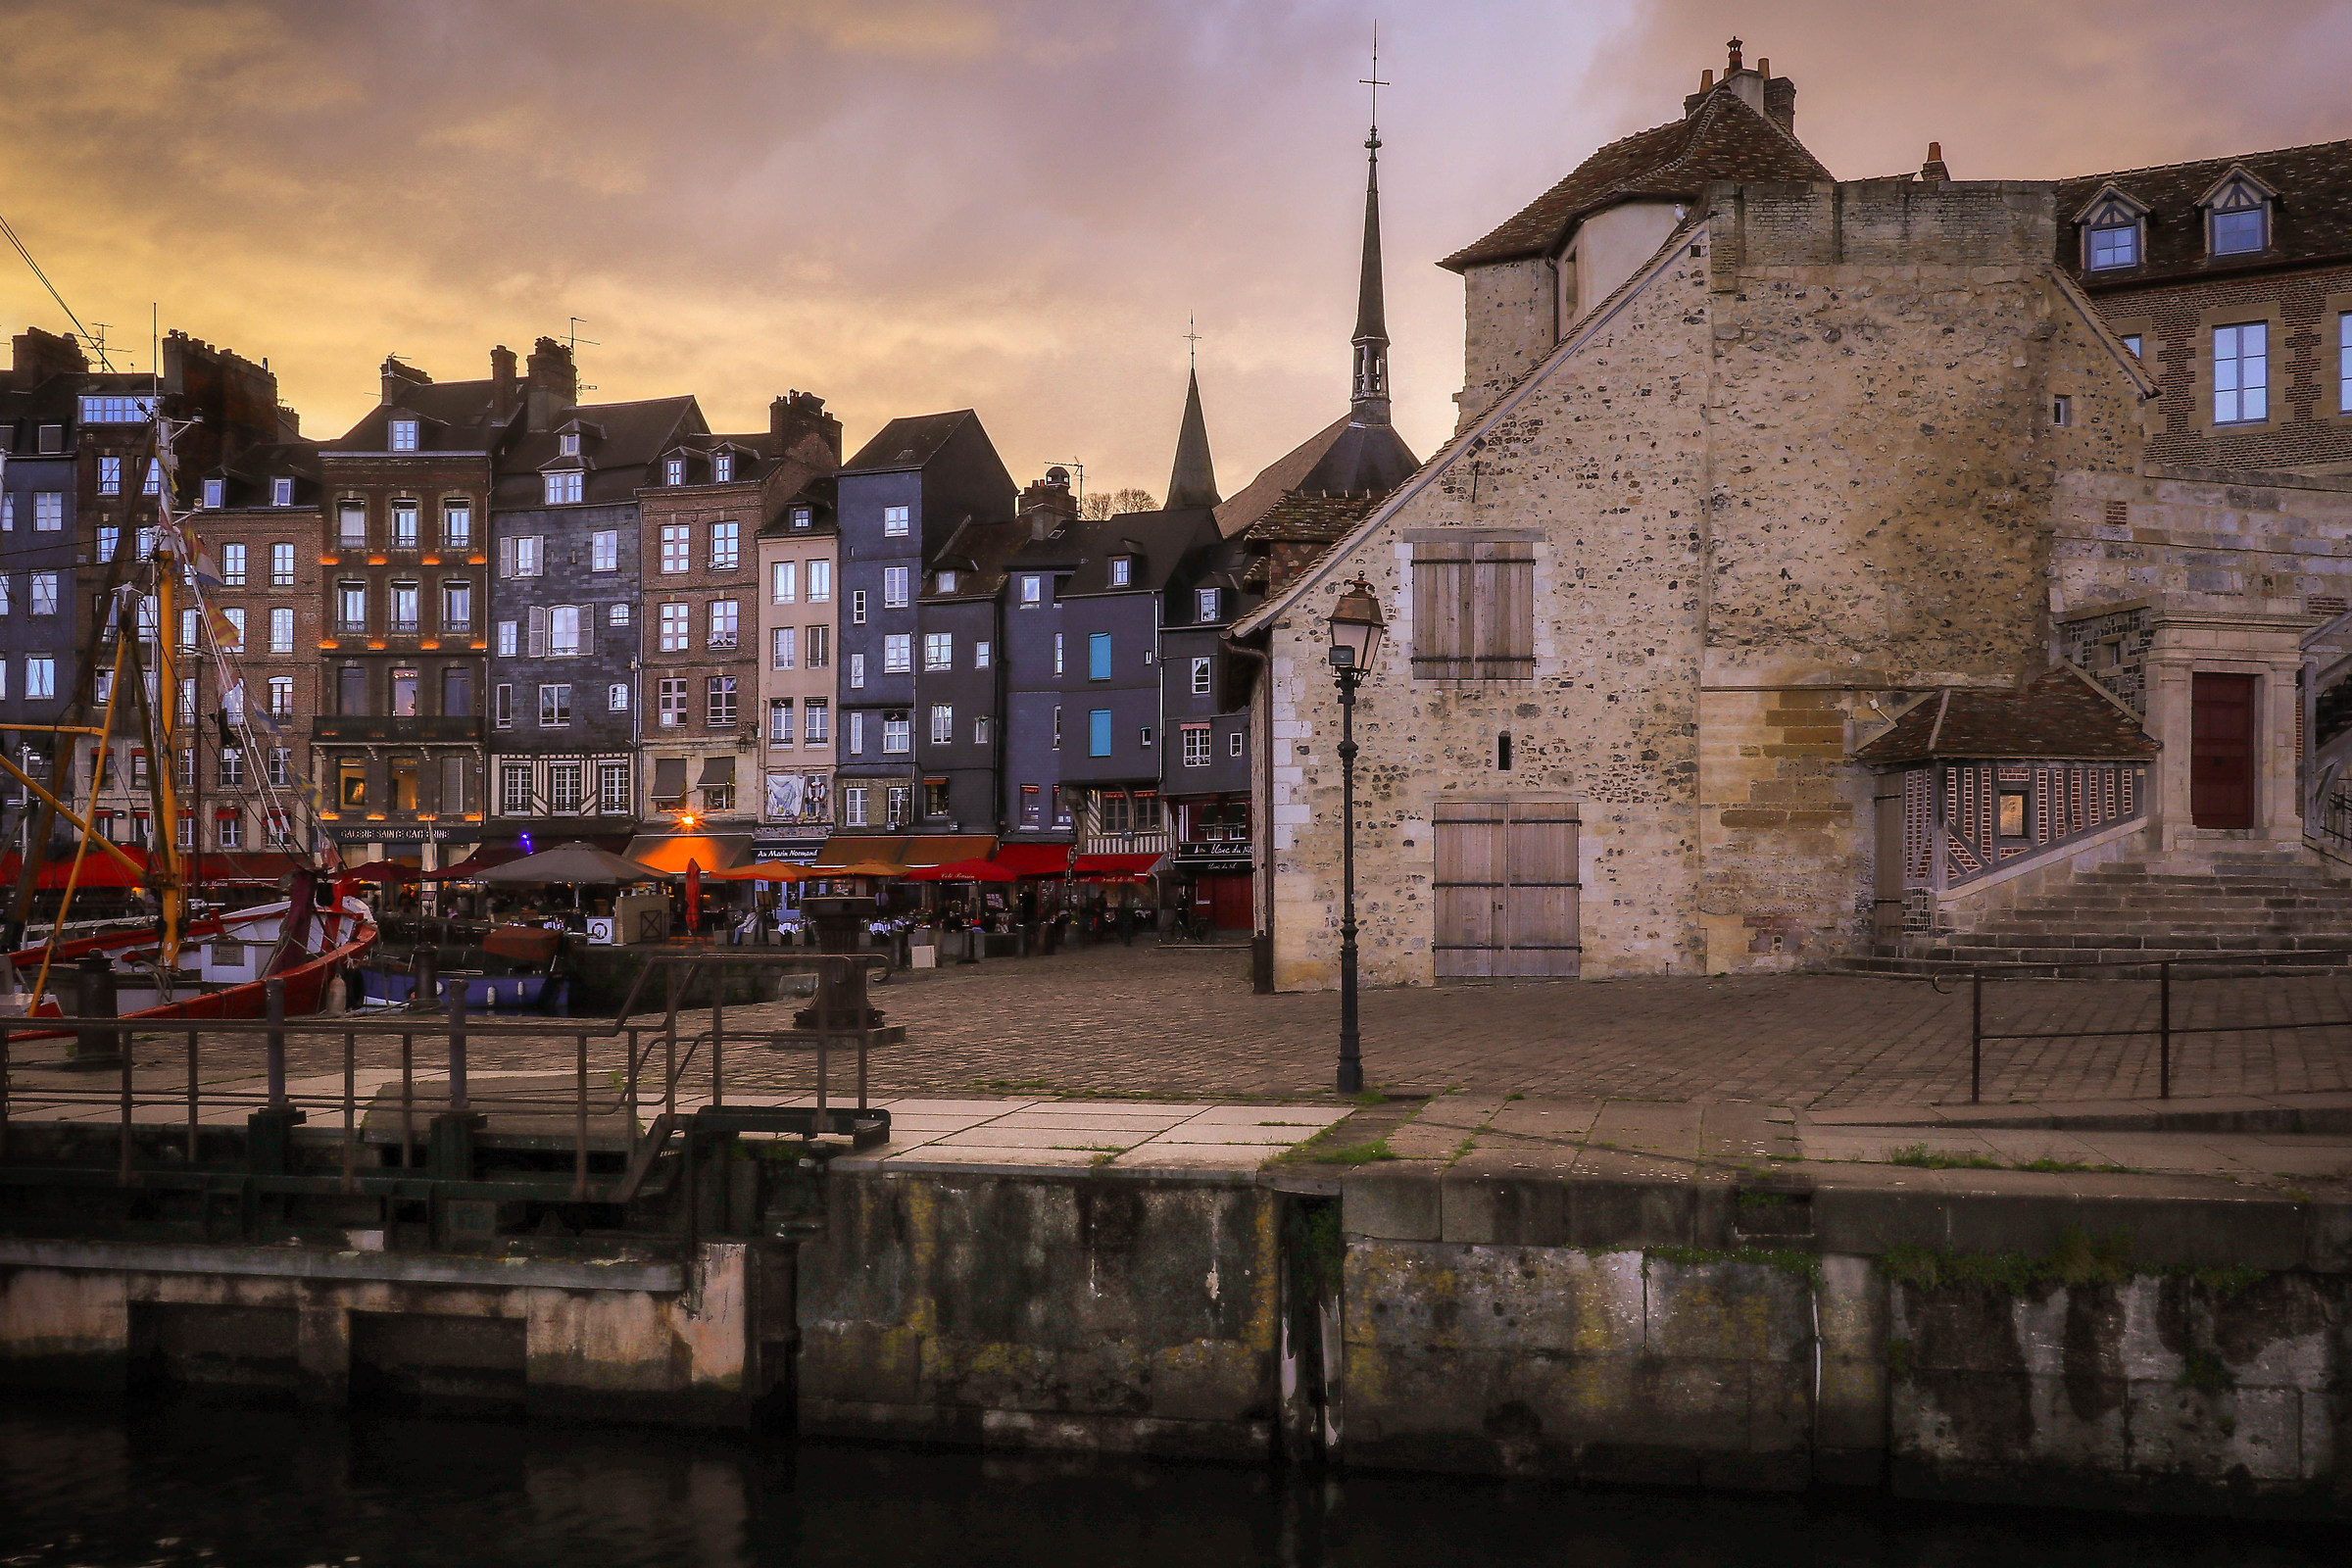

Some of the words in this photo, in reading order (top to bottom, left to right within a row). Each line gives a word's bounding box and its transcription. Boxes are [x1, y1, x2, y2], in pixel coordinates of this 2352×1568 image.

[340, 829, 374, 839] GALERIE
[376, 829, 405, 839] SAINTE
[406, 829, 450, 839] CATHERINE
[789, 849, 818, 858] Normand
